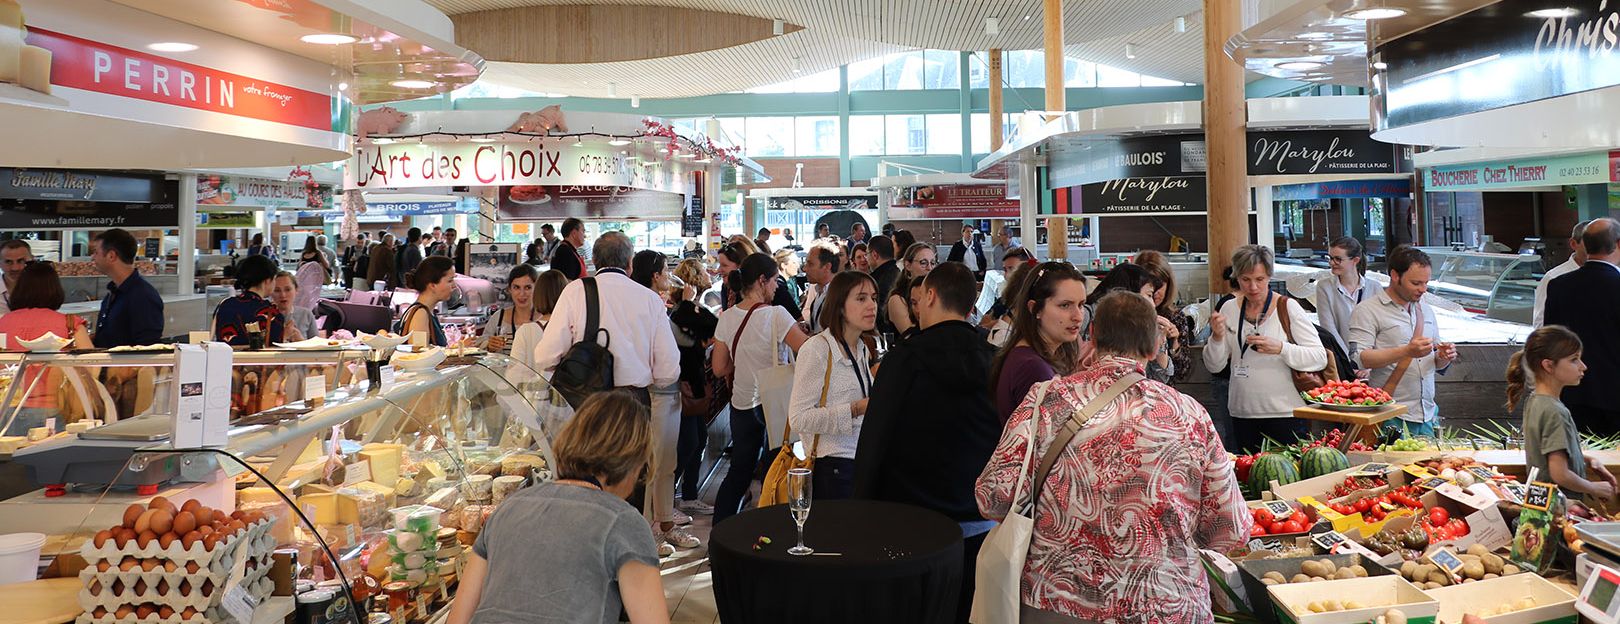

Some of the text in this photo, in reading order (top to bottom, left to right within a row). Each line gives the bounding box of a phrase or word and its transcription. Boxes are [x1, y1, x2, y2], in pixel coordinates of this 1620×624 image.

[93, 51, 235, 108] PERRIN
[242, 83, 293, 107] votre fromager
[579, 154, 590, 174] 06
[592, 156, 602, 173] 78
[1120, 152, 1163, 167] BAULOIS
[1254, 136, 1355, 174] Marylou
[1403, 147, 1411, 161] LE
[357, 144, 562, 187] L'Art des Choix
[11, 169, 97, 199] Famille Mary
[1431, 168, 1479, 187] BOUCHERIE
[1483, 167, 1507, 184] CHEZ
[1508, 165, 1547, 182] THIERRY
[1592, 166, 1600, 175] 16
[271, 184, 282, 199] DES
[960, 187, 1003, 196] TRAITEUR
[377, 203, 420, 212] BRIOIS
[32, 216, 125, 225] www.famillemary.fr
